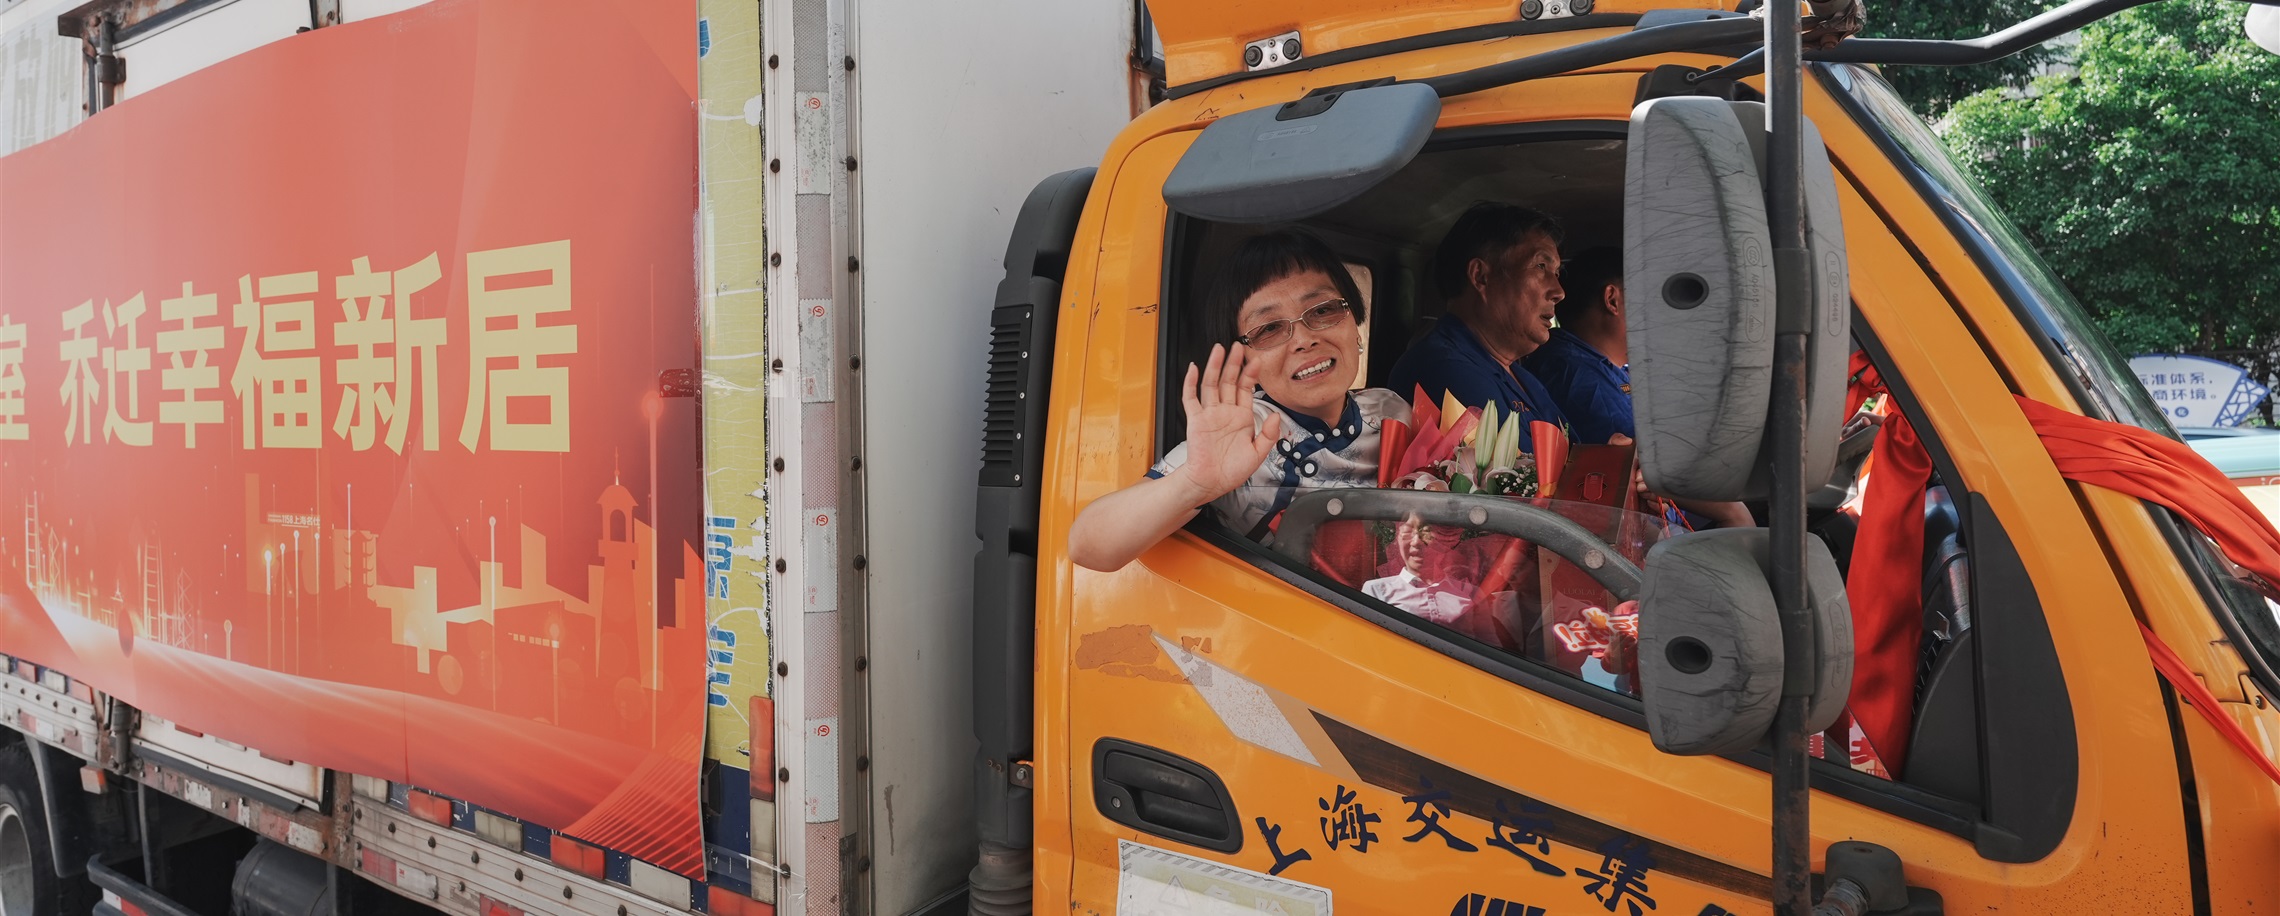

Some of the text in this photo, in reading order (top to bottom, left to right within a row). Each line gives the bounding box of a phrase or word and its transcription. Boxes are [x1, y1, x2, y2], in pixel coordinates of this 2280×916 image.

[59, 239, 578, 456] 乔迁幸福新居
[1563, 587, 1596, 596] LUOLAI
[1255, 776, 1732, 916] 上海交运集
